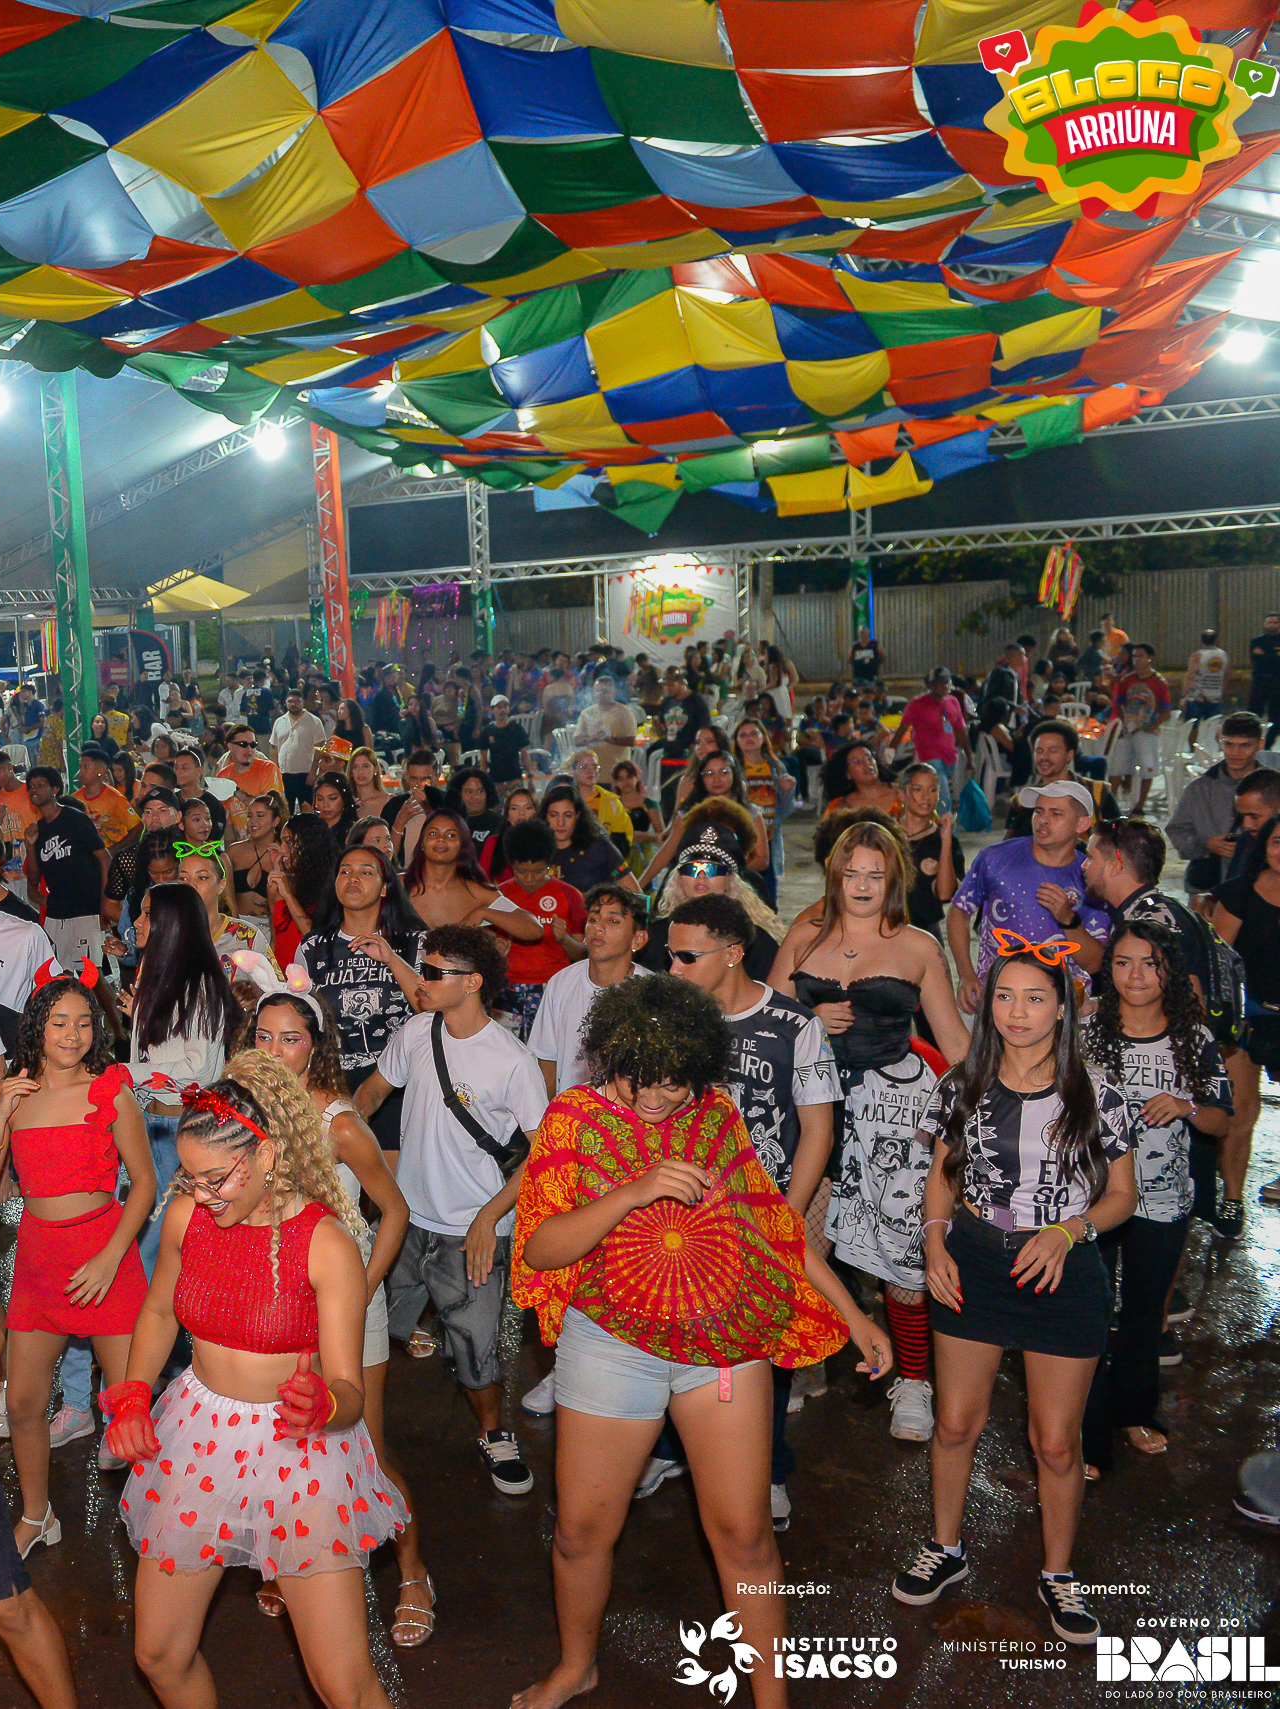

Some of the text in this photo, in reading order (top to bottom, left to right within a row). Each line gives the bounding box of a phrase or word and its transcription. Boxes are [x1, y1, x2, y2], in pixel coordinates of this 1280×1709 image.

[142, 650, 162, 681] BAR
[348, 957, 377, 967] BEATO
[321, 966, 397, 987] JUAZEIR
[743, 1038, 757, 1051] DE
[1155, 1055, 1170, 1066] DE
[1125, 1066, 1175, 1092] ZEIR
[880, 1090, 910, 1106] BEATO
